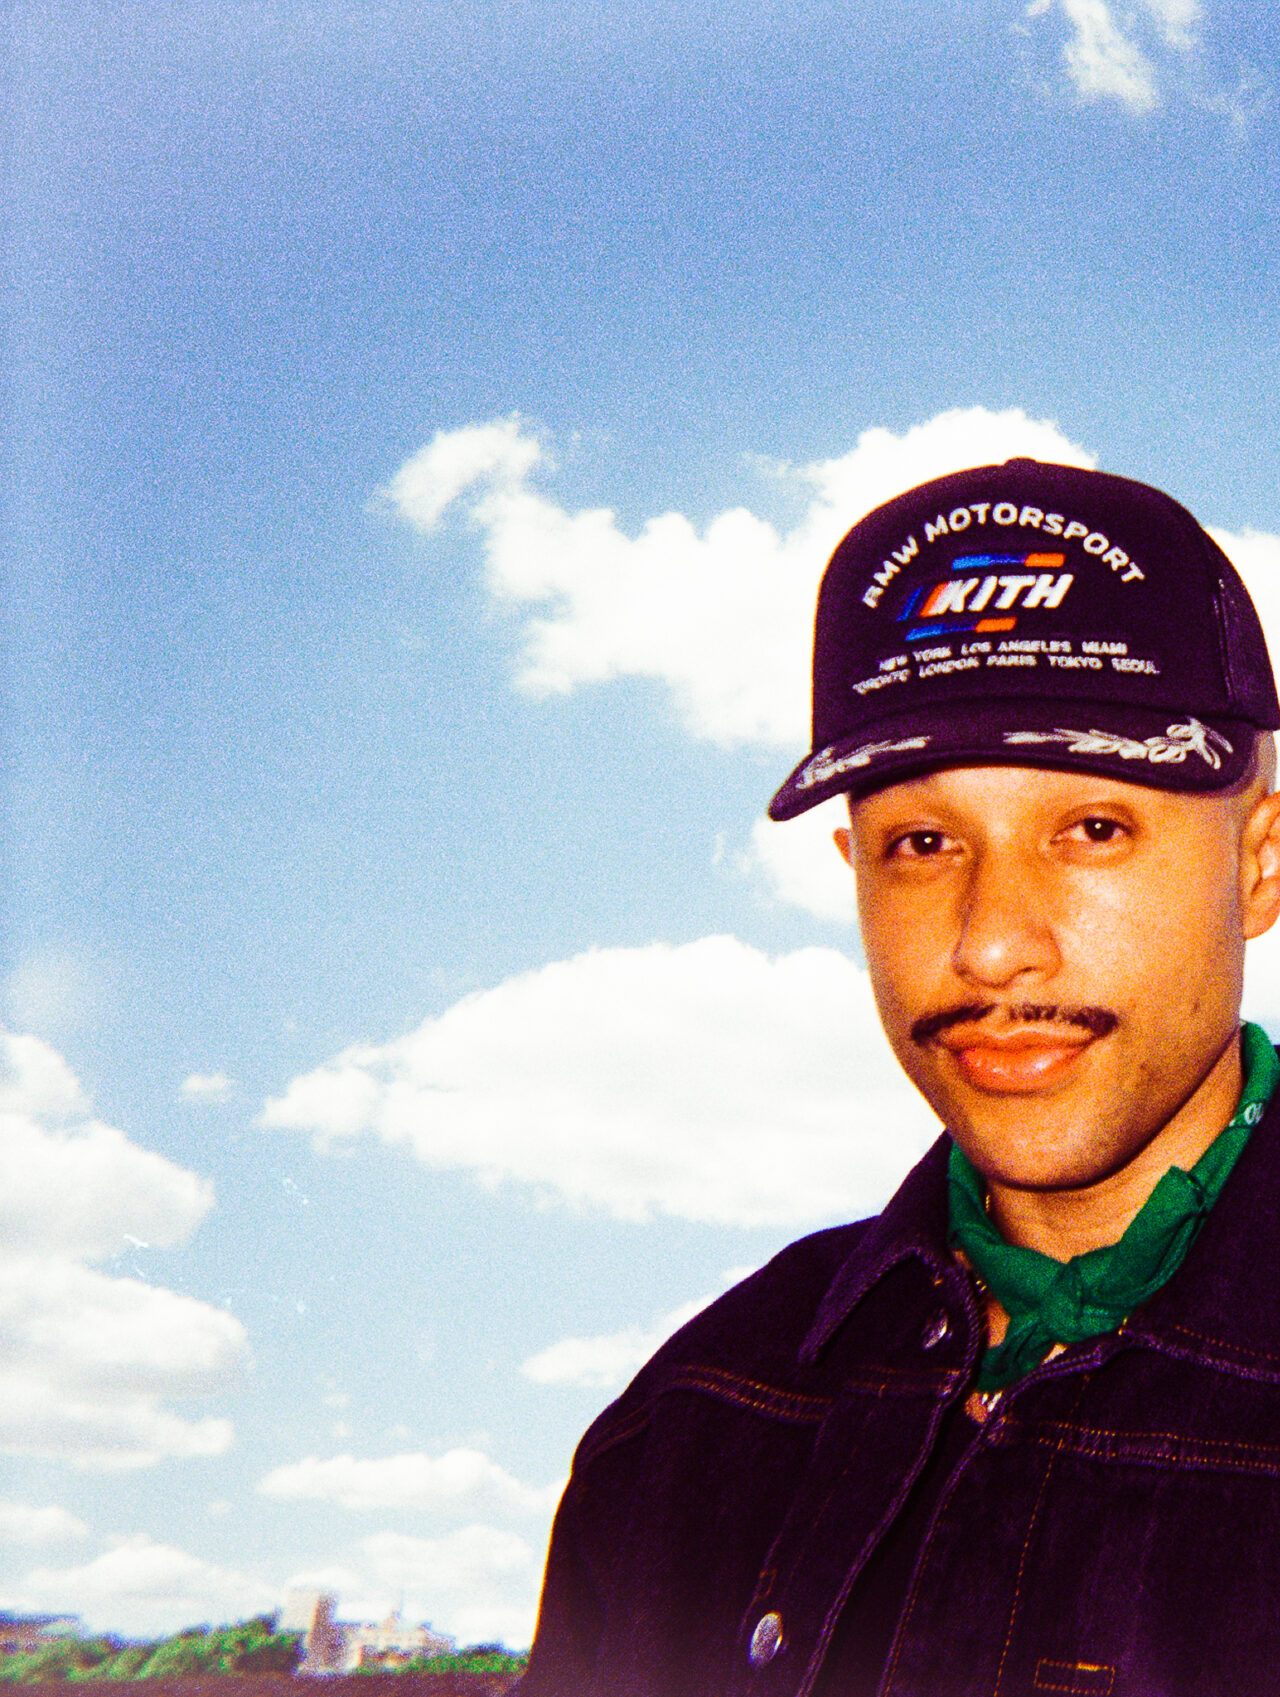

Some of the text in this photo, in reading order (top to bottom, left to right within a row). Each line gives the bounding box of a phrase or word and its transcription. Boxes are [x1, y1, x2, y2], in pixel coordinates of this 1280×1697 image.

[924, 502, 1145, 583] MOTORSPORT
[928, 573, 1074, 616] KITH
[913, 646, 952, 662] YORK
[961, 641, 992, 656] LOS
[997, 640, 1072, 653] ANGELES
[1082, 641, 1128, 655] MIAMI
[919, 656, 980, 678] LONDON
[986, 654, 1037, 667] PARIS
[1048, 655, 1103, 670] TOKYO
